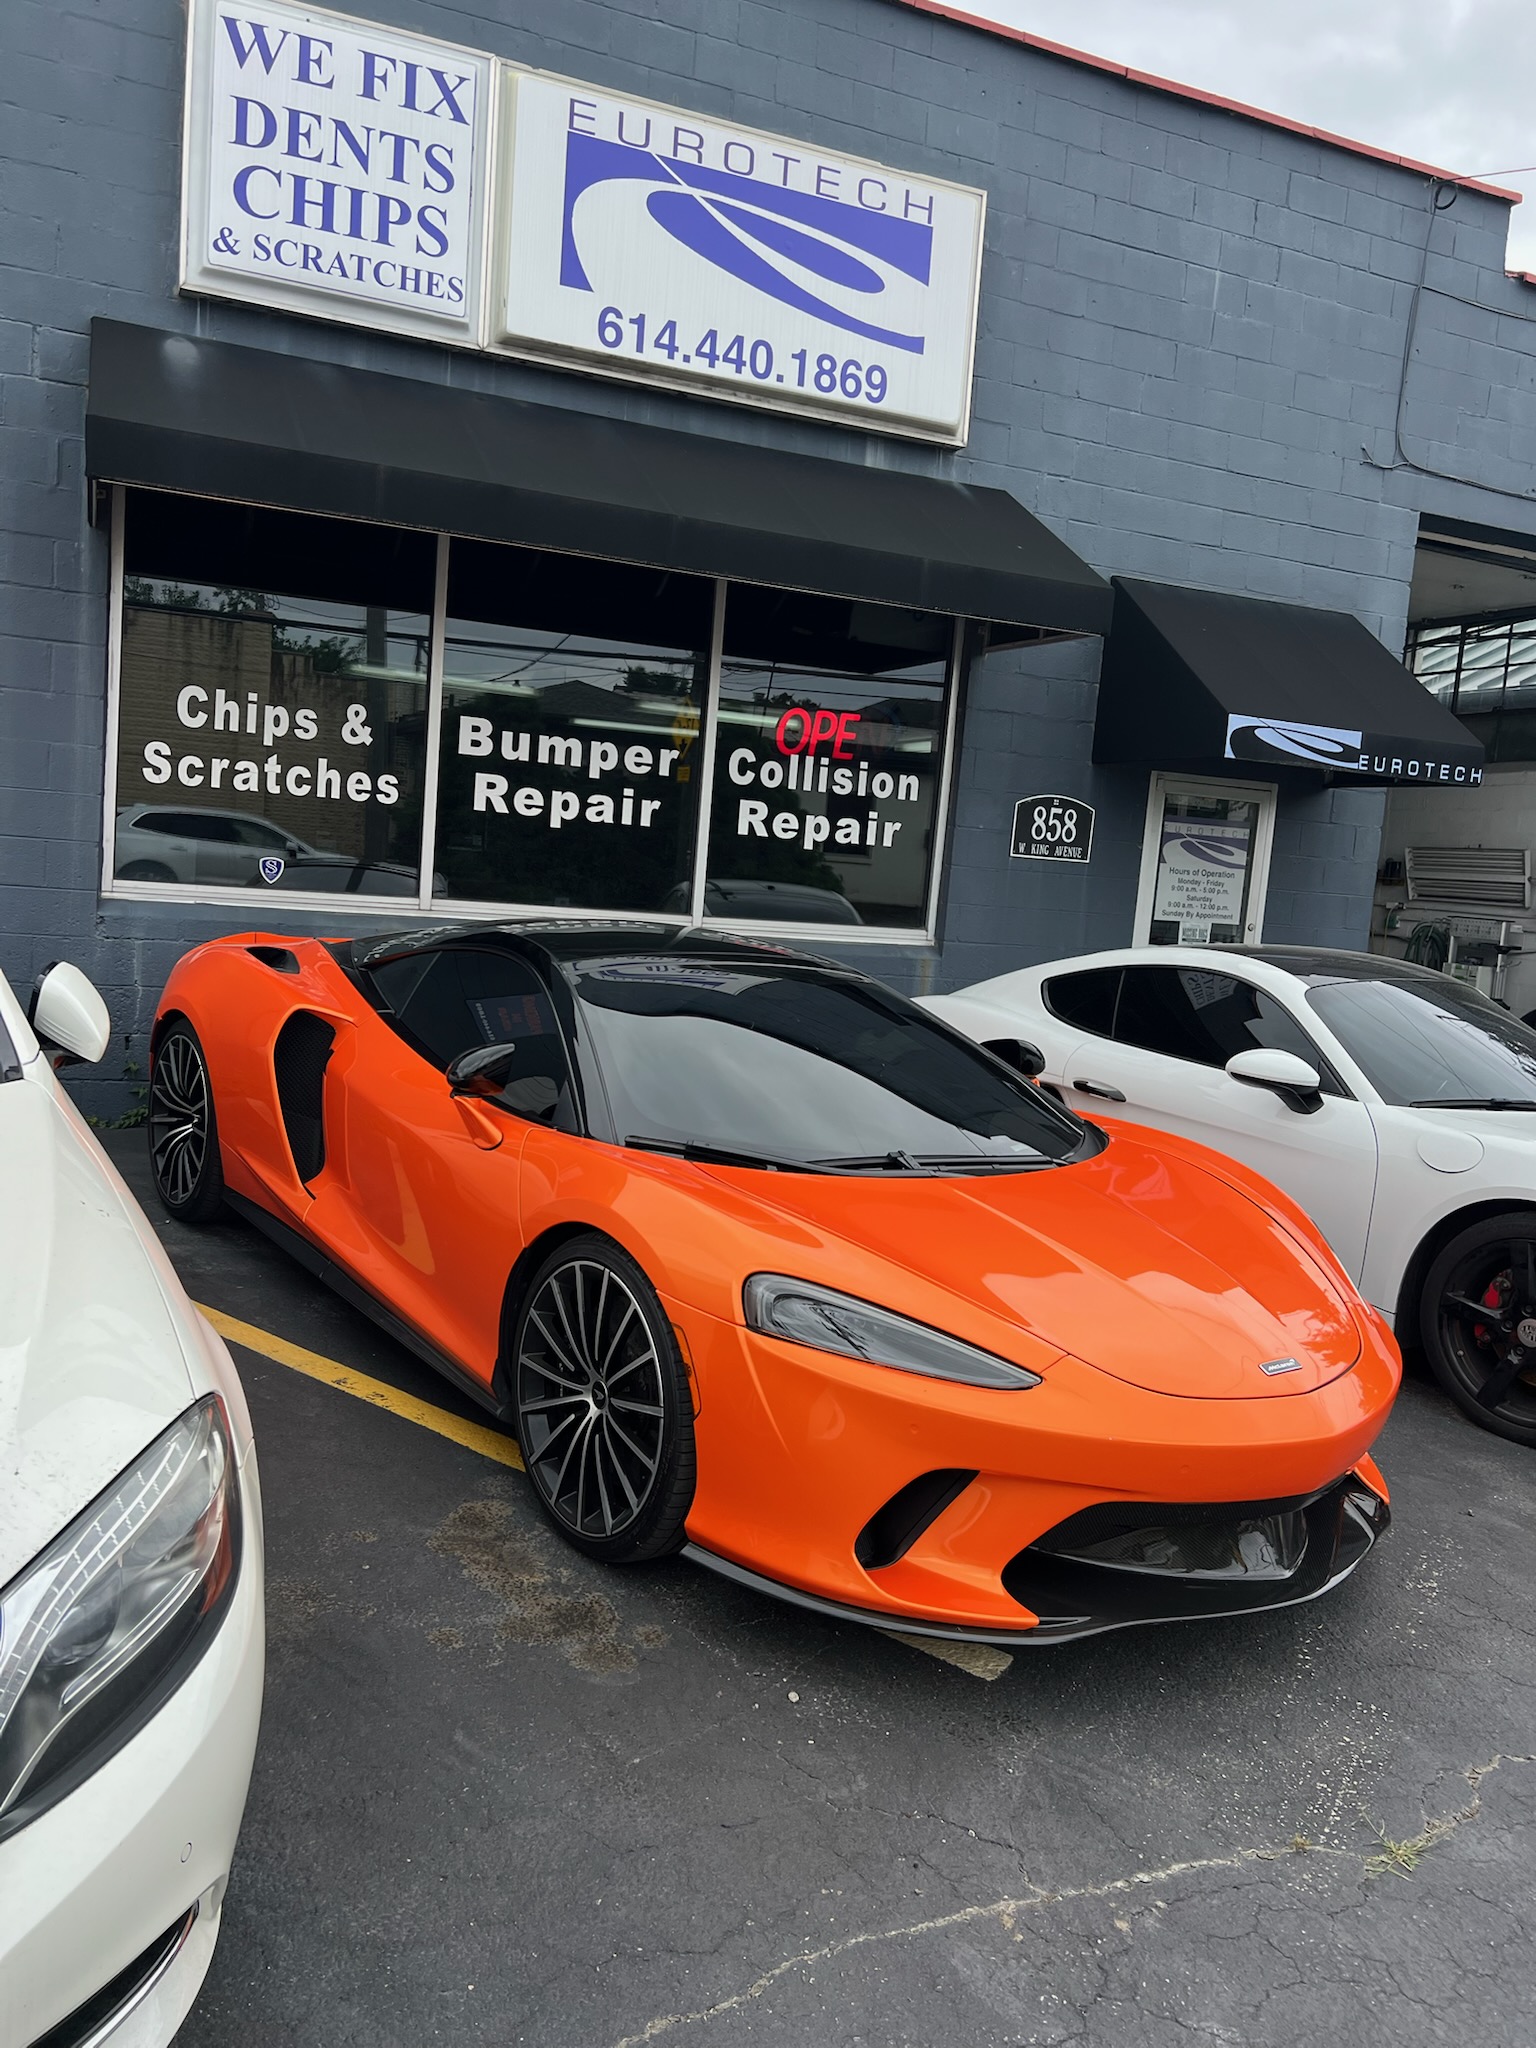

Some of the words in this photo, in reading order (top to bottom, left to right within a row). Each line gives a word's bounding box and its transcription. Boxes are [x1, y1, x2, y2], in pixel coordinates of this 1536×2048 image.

[219, 14, 335, 90] WE
[356, 49, 470, 126] FIX
[228, 95, 456, 194] DENTS
[567, 97, 934, 225] EUROTECH
[232, 164, 449, 258] CHIPS
[212, 226, 241, 256] &
[253, 233, 464, 302] SCRATCHES
[597, 306, 888, 404] 614.440.1869
[176, 684, 318, 746] Chips
[340, 703, 374, 747] &
[141, 740, 399, 804] Scratches
[457, 715, 680, 780] Bumper
[728, 747, 920, 802] Collision
[1359, 754, 1482, 784] EUROTECH
[472, 772, 662, 829] Repair
[737, 799, 902, 850] Repair
[1031, 806, 1077, 843] 858
[1031, 843, 1050, 855] KING
[1054, 846, 1082, 858] AVENUE
[1169, 867, 1190, 876] Hours
[1201, 869, 1235, 878] Operation
[1178, 878, 1201, 886] Monday
[1206, 880, 1224, 888] Friday
[1186, 894, 1212, 903] Saturday
[1161, 909, 1184, 918] Sunday
[1186, 910, 1194, 919] By
[1195, 912, 1233, 920] Appointment
